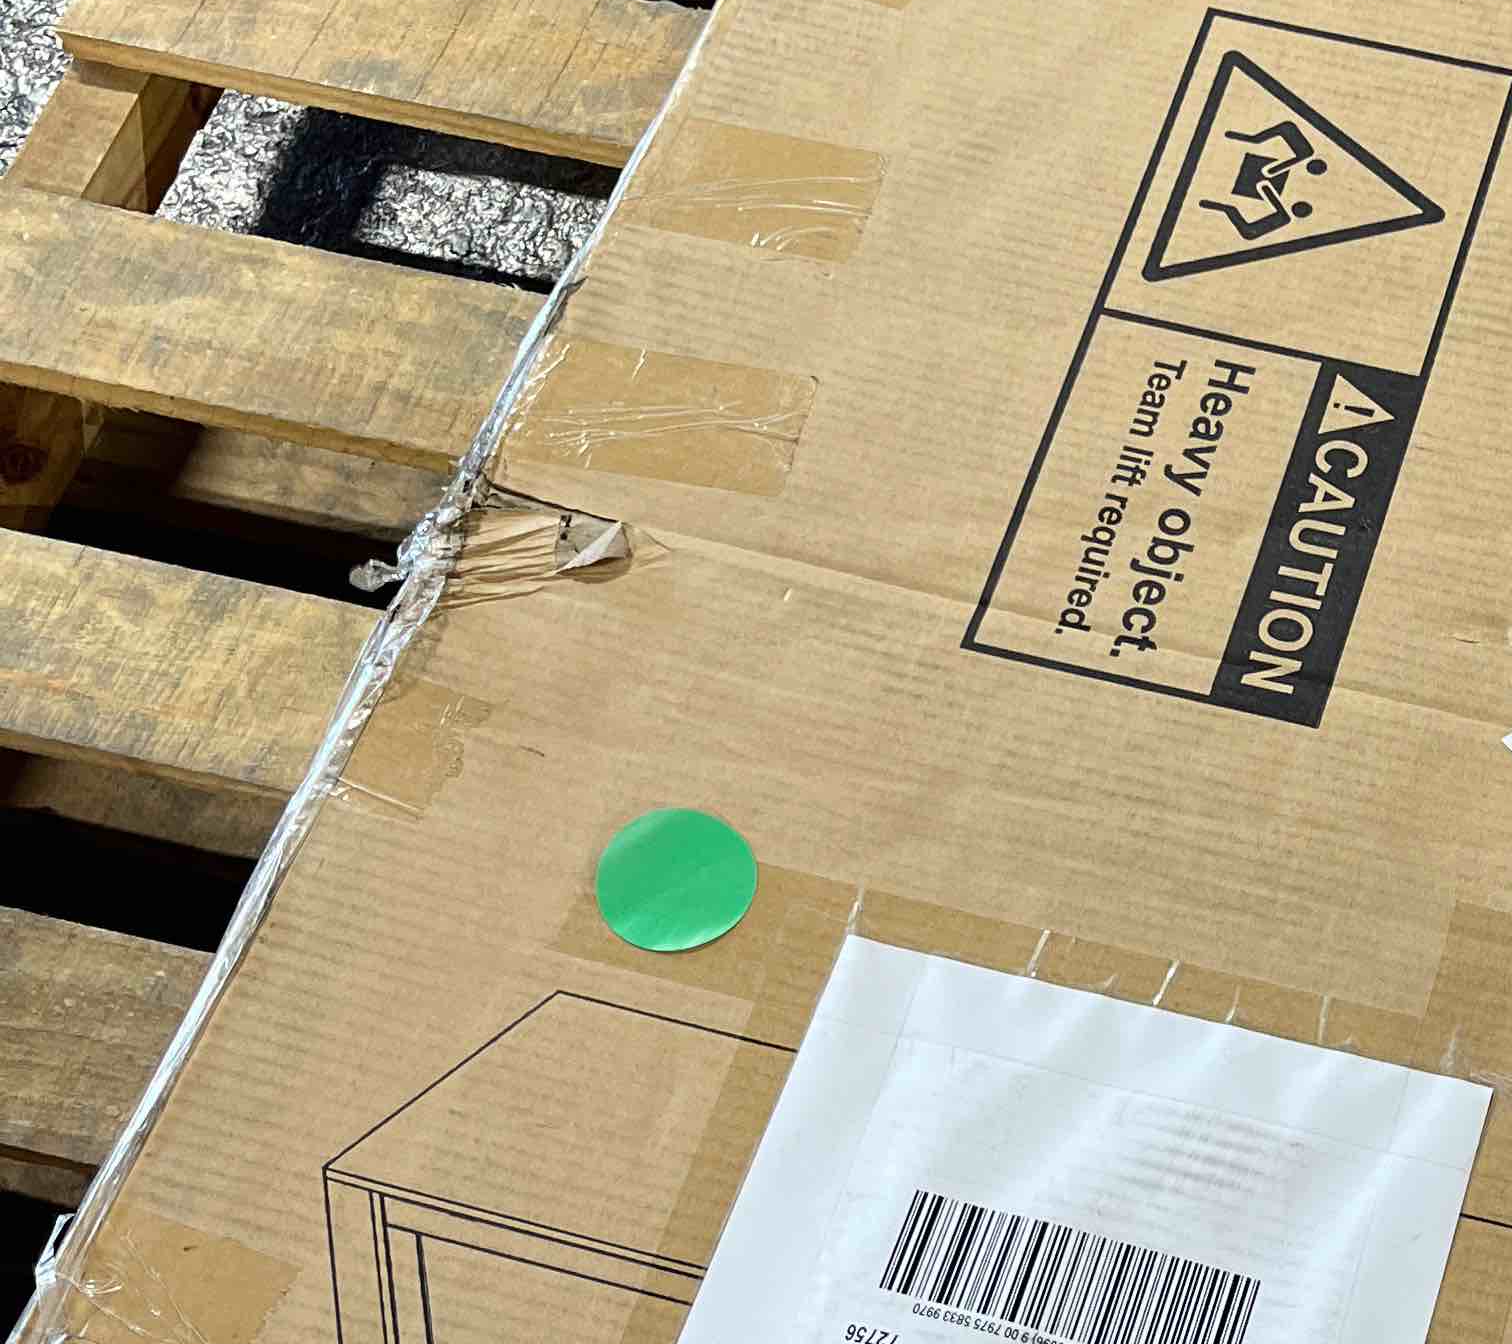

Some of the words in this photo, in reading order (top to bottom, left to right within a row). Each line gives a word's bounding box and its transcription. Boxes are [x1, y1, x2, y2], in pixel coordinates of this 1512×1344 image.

[1129, 358, 1188, 437] Team
[1164, 359, 1257, 497] Heavy
[1110, 445, 1154, 488] lift
[1054, 492, 1129, 635] required.
[1109, 507, 1195, 658] object.
[1239, 439, 1369, 695] CAUTION
[912, 1302, 941, 1319] 9970
[943, 1310, 971, 1329] 5833
[972, 1318, 1002, 1337] 7975
[1004, 1325, 1019, 1342] 00
[1021, 1330, 1029, 1344] 9
